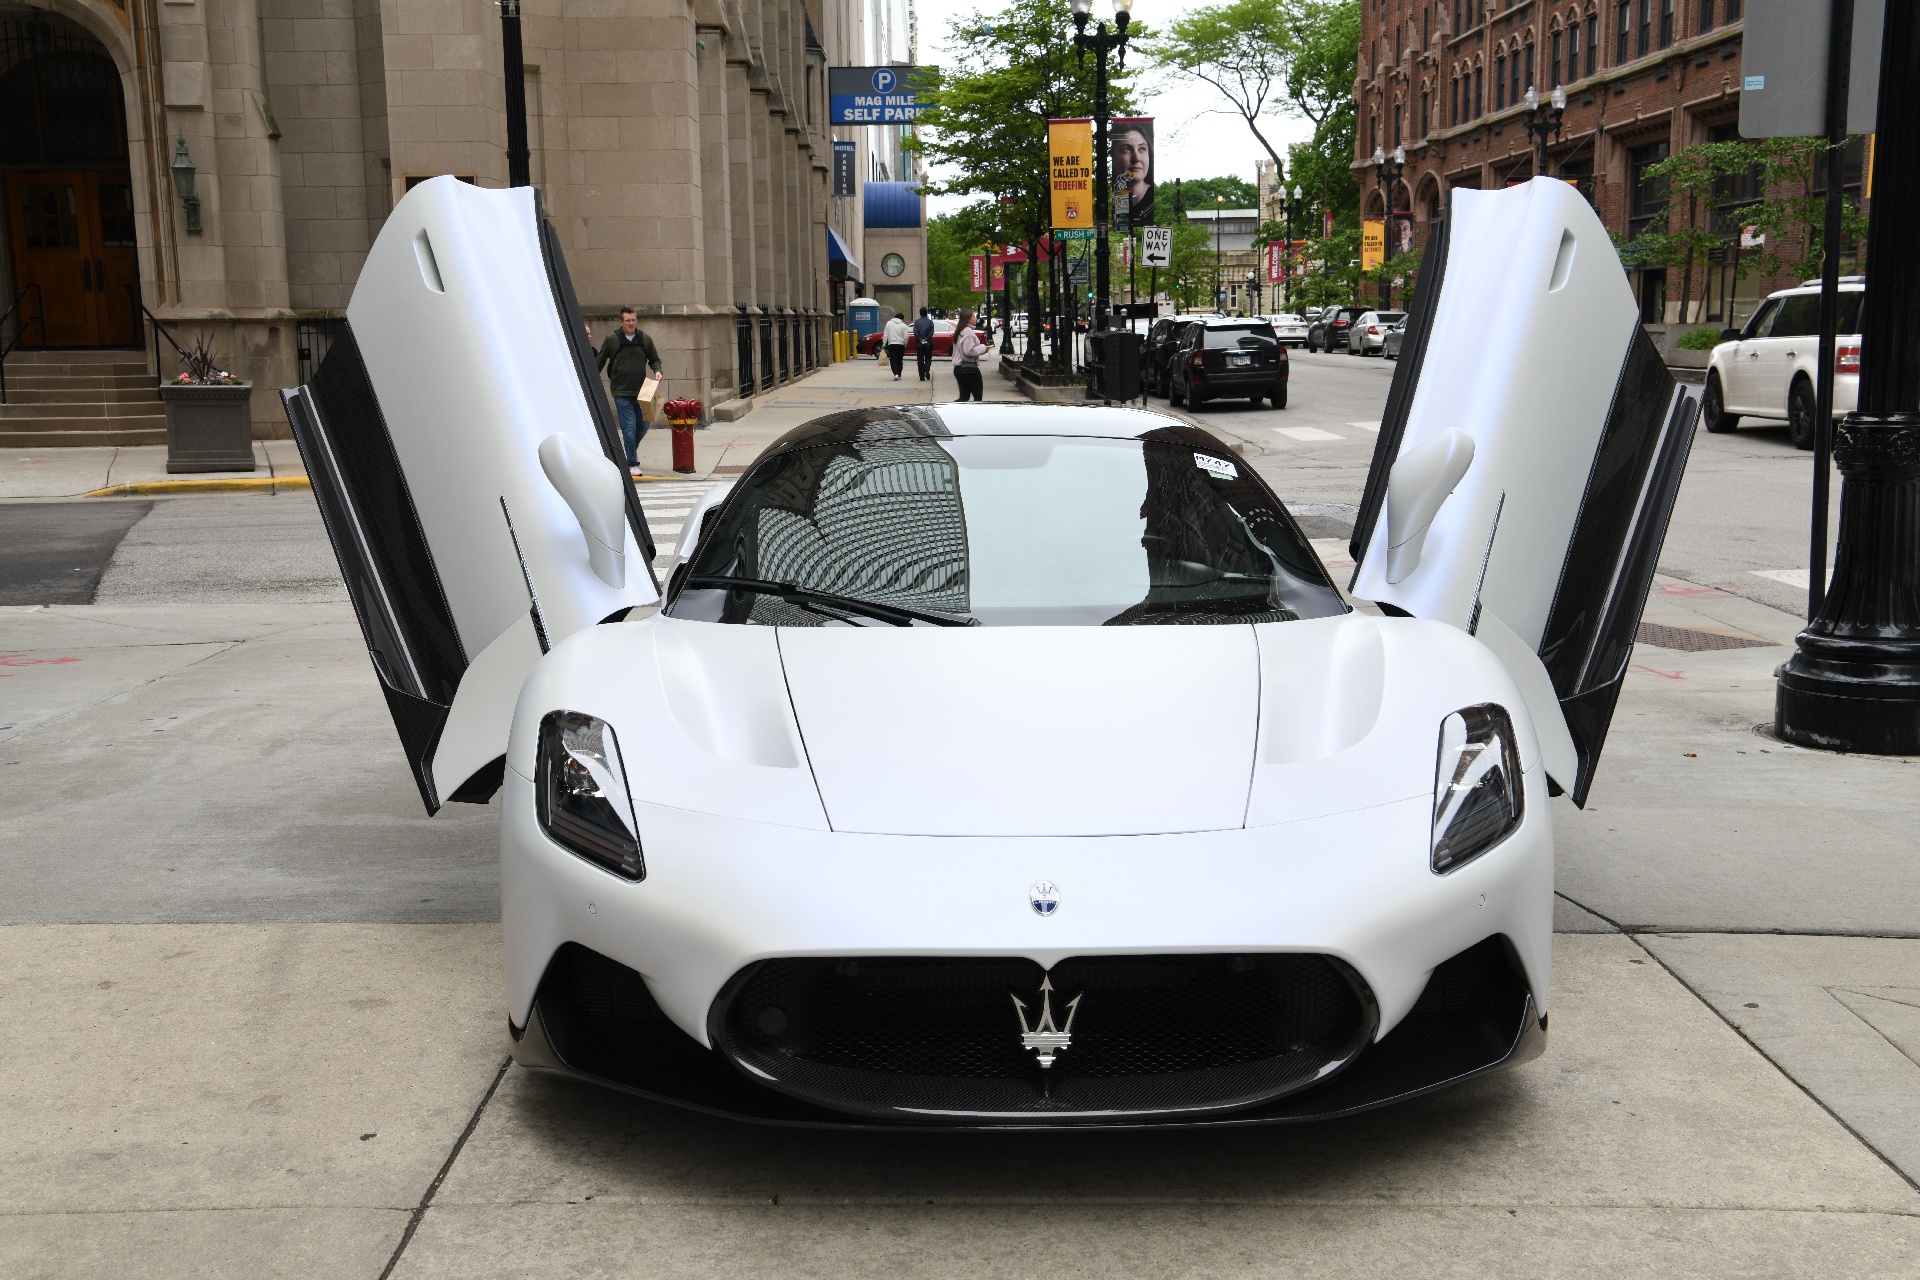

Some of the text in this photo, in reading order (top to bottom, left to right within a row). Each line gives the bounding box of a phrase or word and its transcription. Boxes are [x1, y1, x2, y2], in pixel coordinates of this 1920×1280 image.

[878, 72, 892, 90] P
[854, 95, 915, 106] MAG MILE
[843, 108, 881, 121] SELF
[1053, 156, 1080, 166] WE ARE
[1053, 168, 1090, 179] CALLED TO
[1053, 180, 1088, 191] REDEFINE
[1063, 230, 1085, 239] RUSH
[1146, 230, 1169, 241] ONE
[1145, 241, 1168, 252] WAY
[1271, 245, 1279, 279] WELCOME
